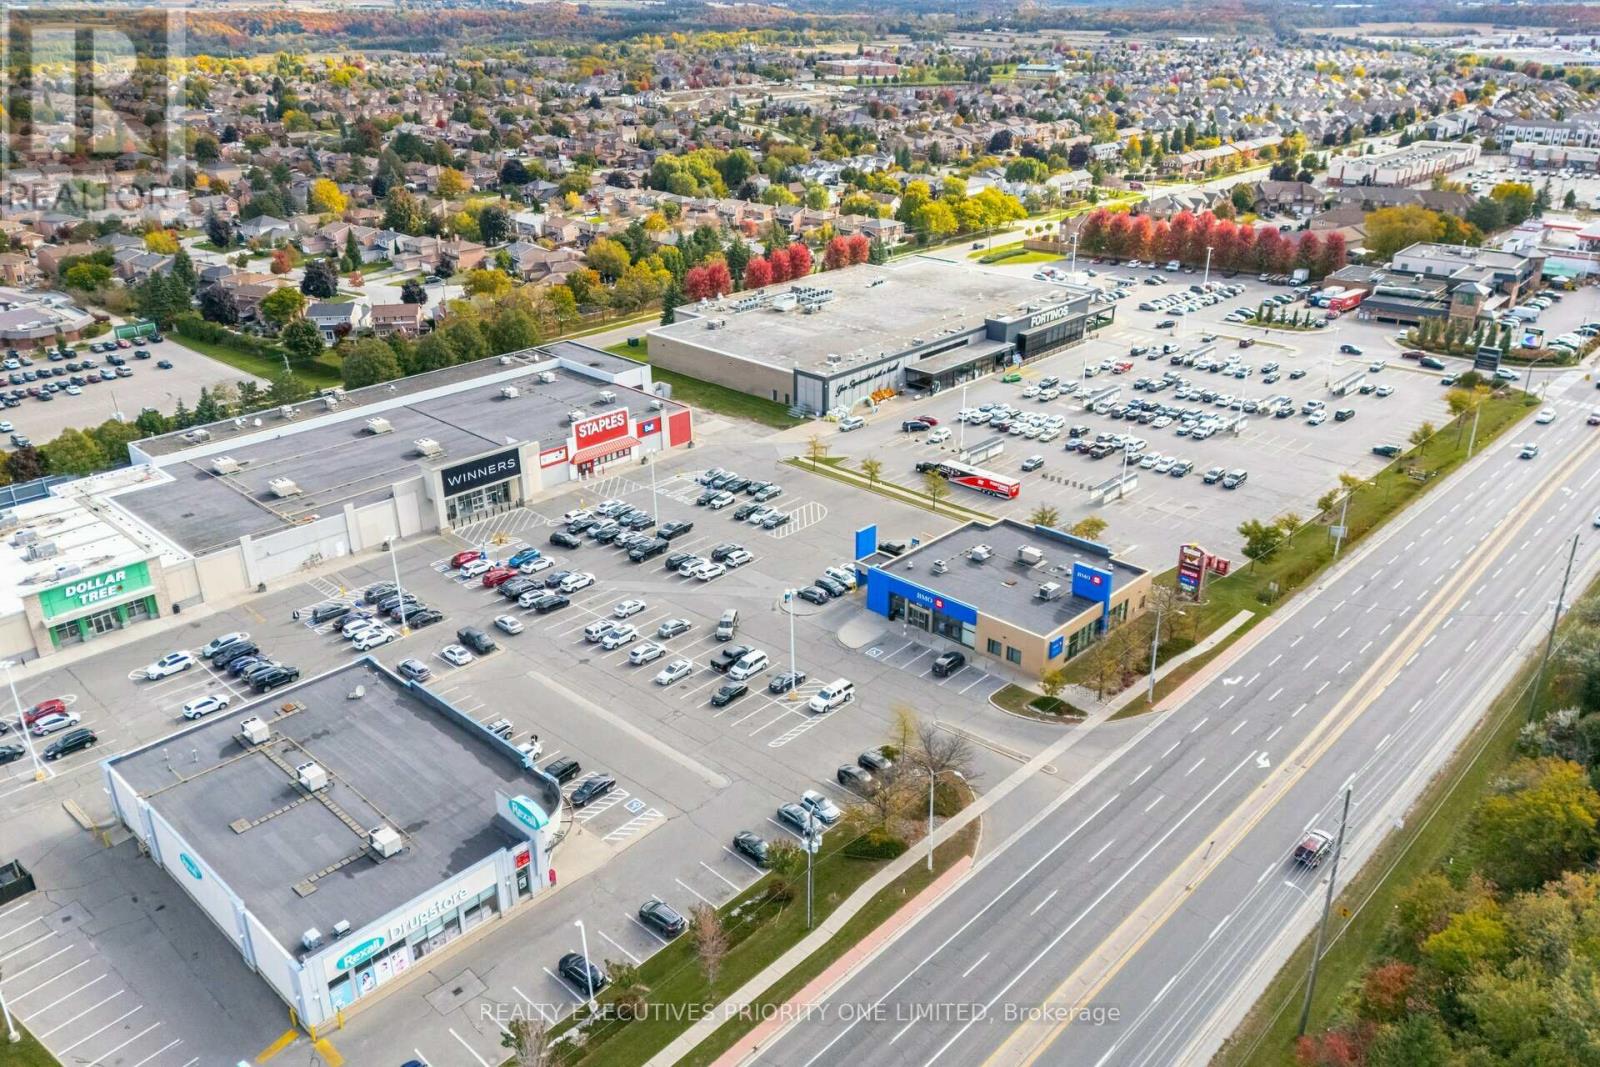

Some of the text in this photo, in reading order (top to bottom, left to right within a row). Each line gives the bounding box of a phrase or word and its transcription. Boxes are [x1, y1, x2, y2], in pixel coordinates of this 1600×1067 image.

[1030, 305, 1069, 328] FORTINOS
[578, 413, 625, 438] STAPLES
[447, 458, 516, 487] WINNERS
[65, 570, 126, 597] DOLLAR
[79, 585, 117, 605] TREE
[916, 592, 933, 603] BMO
[512, 802, 537, 828] Rexall
[343, 888, 468, 968] Rexall Drugstore
